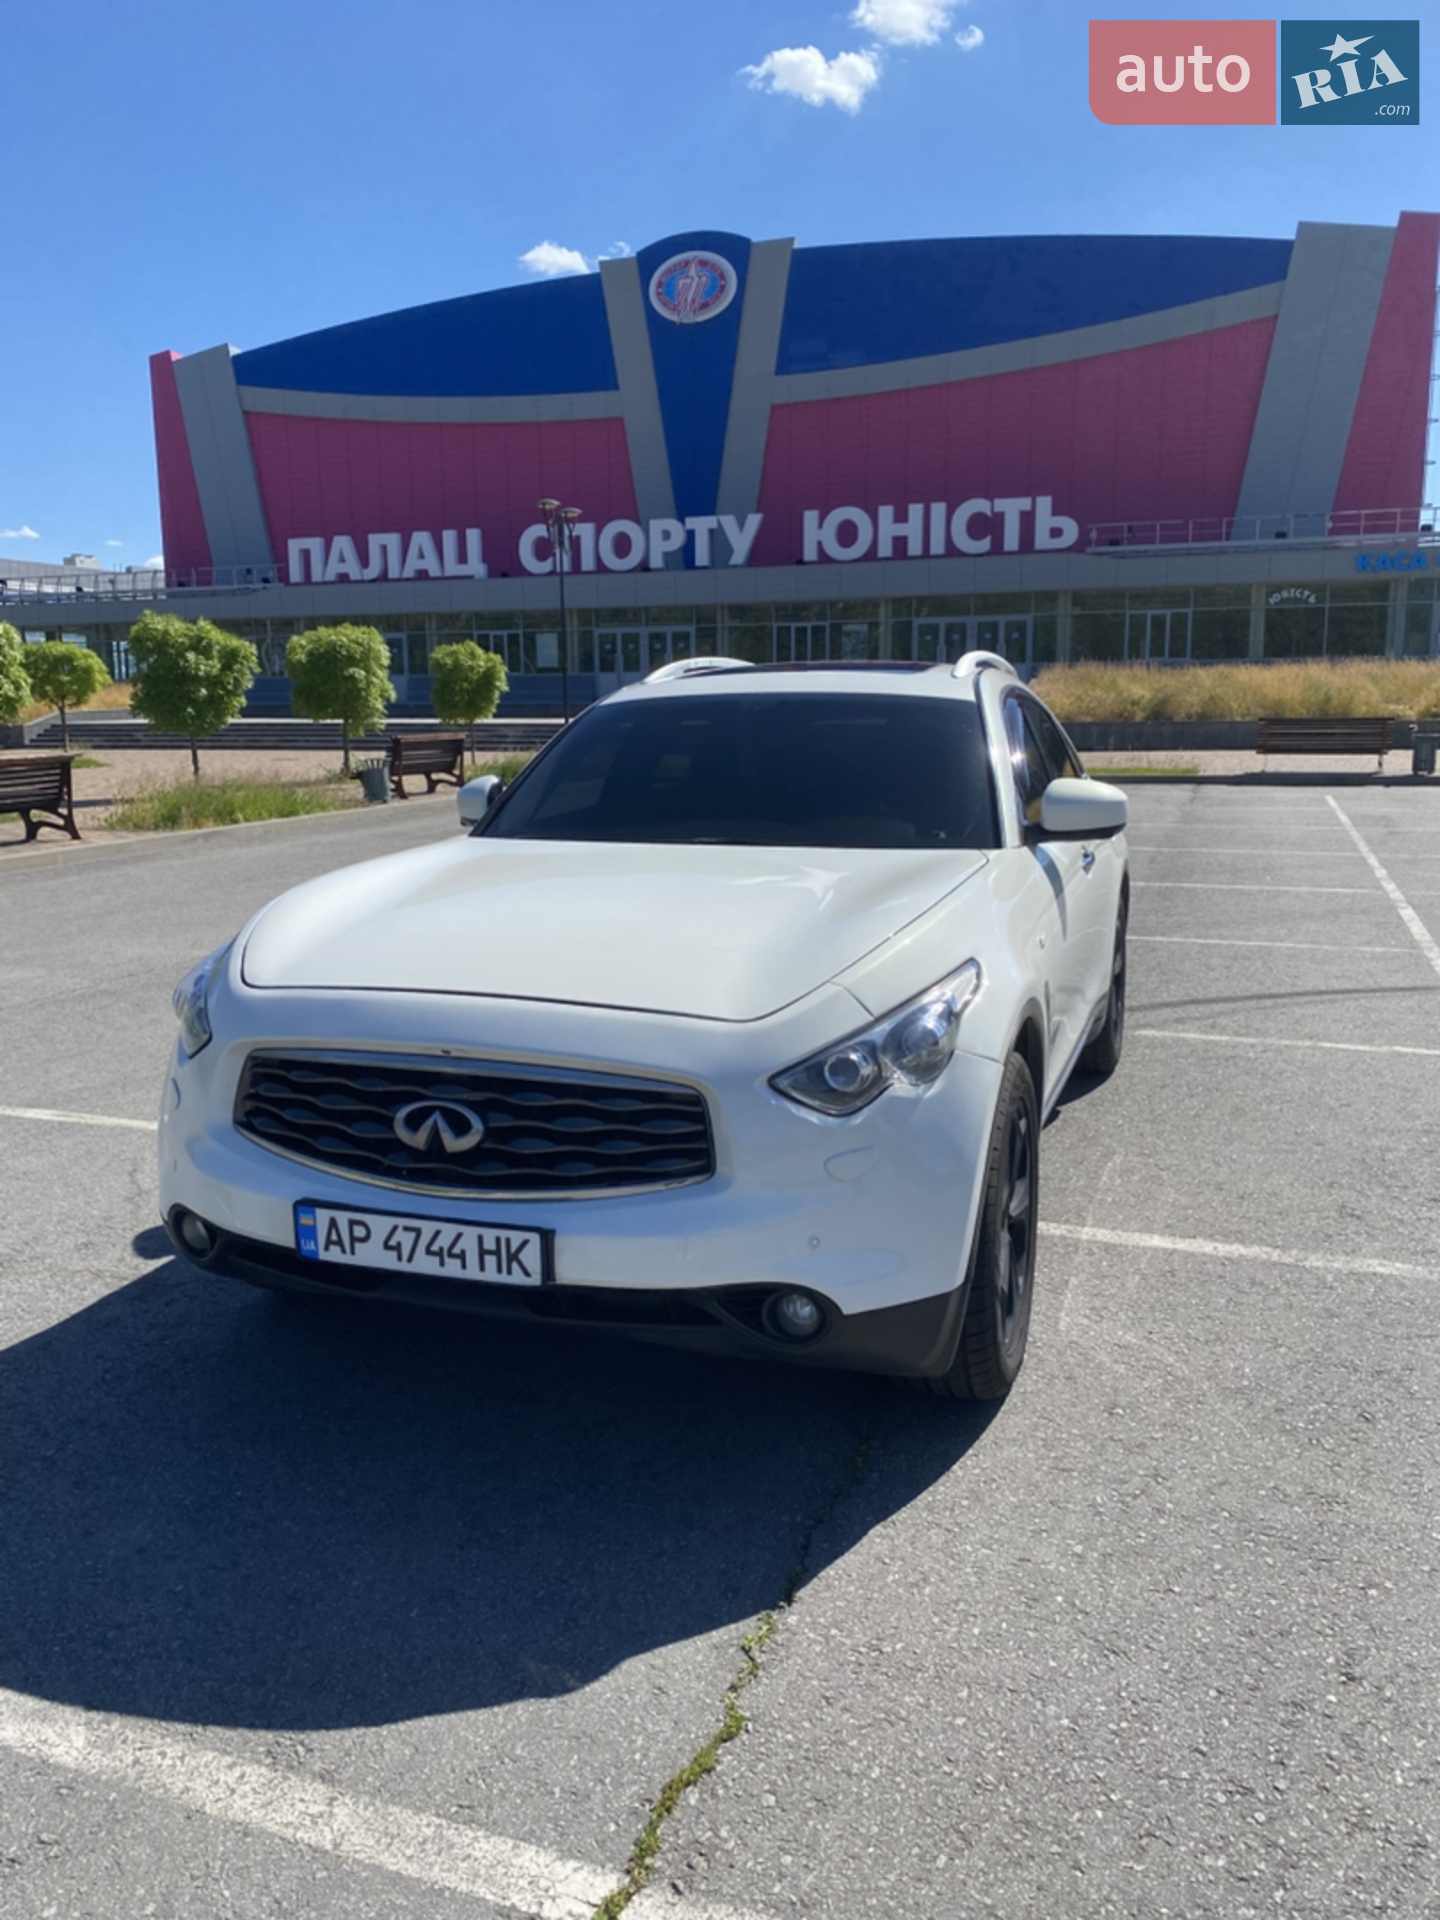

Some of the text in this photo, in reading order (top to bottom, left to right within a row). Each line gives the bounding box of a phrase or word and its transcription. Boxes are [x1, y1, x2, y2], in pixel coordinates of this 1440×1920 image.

[287, 495, 1080, 584] ПАЛАЦ СПОРТУ ЮНІСТЬ
[1356, 550, 1428, 573] КАСА
[301, 1216, 533, 1278] UA AP 4744 HK
